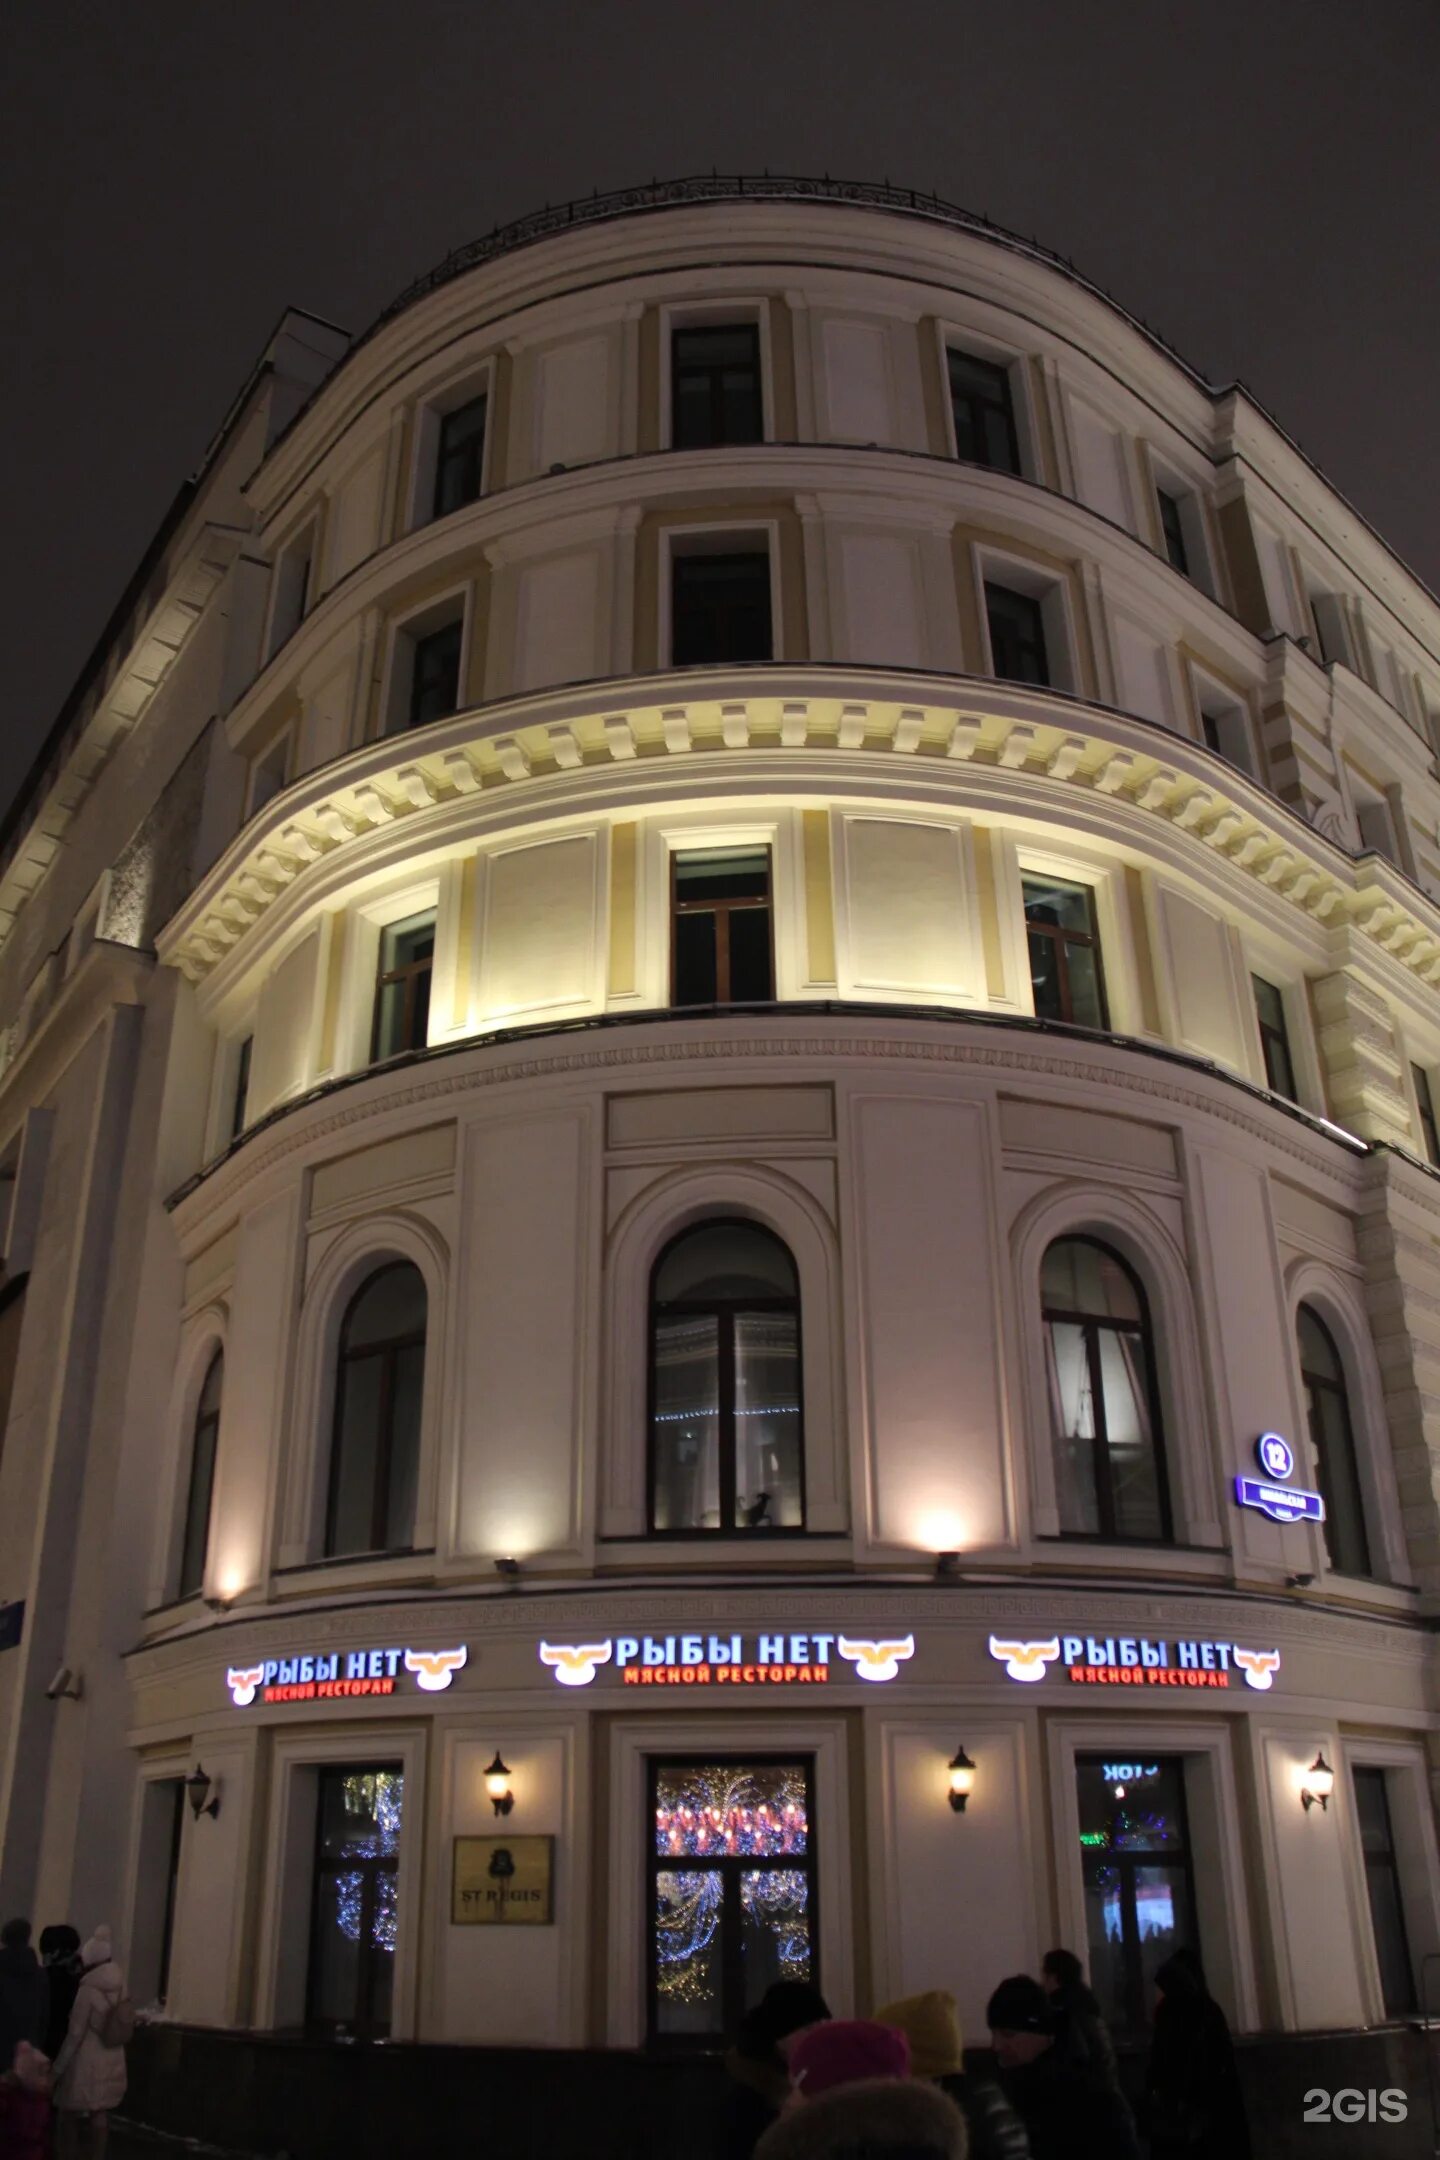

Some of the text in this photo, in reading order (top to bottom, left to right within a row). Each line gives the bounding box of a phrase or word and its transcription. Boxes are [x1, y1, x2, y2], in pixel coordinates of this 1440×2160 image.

[1266, 1442, 1287, 1472] 12
[615, 1634, 834, 1667] РЫБЫ НЕТ
[1063, 1637, 1231, 1671] РЫБЫ НЕТ
[264, 1650, 402, 1686] РЫБЫ НЕТ
[624, 1664, 828, 1684] МЯСНОЙ РЕСТОРАН
[1070, 1665, 1228, 1687] МЯСНОЙ РЕСТОРАН
[264, 1679, 394, 1702] МЯСНОЙ РЕСТОРАН
